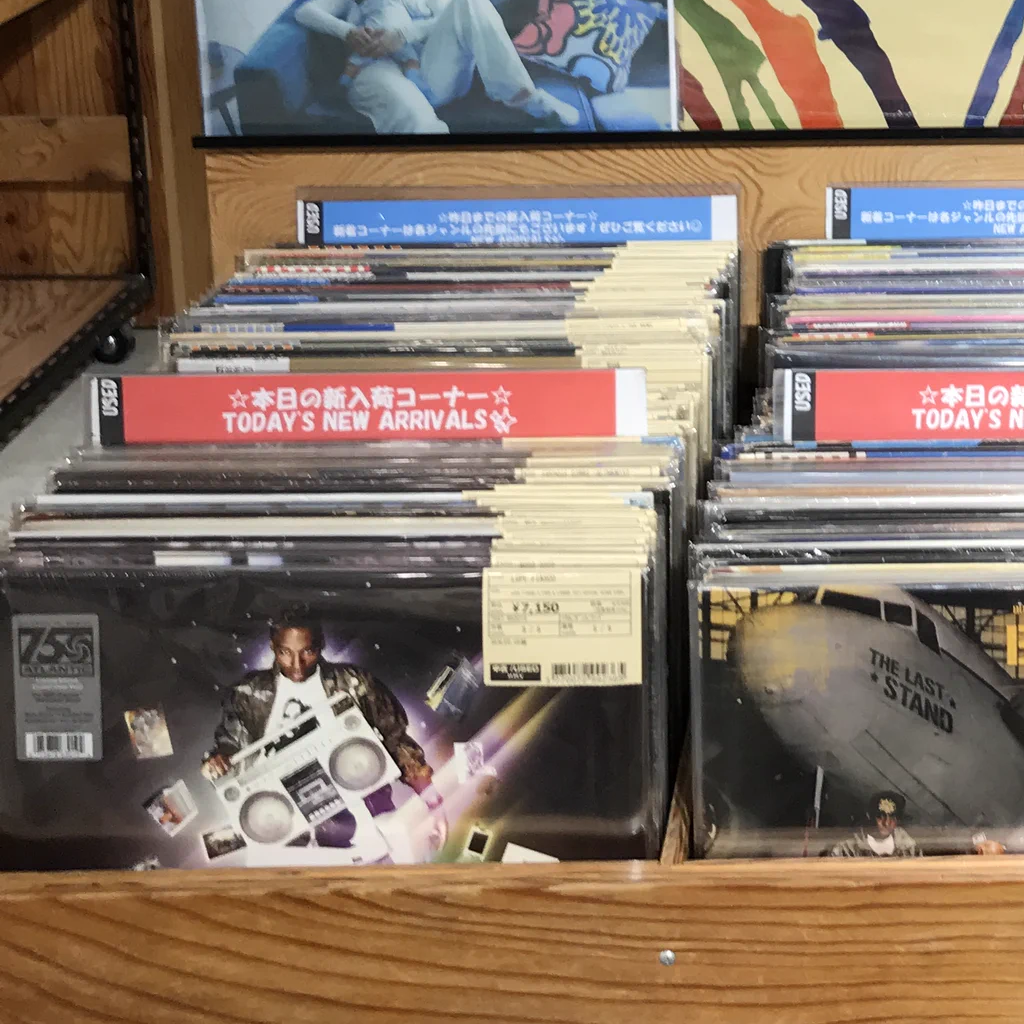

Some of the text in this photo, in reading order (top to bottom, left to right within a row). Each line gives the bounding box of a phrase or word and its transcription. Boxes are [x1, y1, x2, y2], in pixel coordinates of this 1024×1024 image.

[833, 189, 848, 220] USED
[993, 224, 1017, 235] NEW
[101, 378, 118, 417] USED
[794, 372, 812, 412] USED
[222, 409, 488, 433] TODAY'S NEW ARRIVALS
[911, 408, 1002, 430] TODAY'S
[513, 602, 560, 615] ¥7,150
[869, 647, 945, 700] THE LAST
[883, 676, 954, 734] STAND
